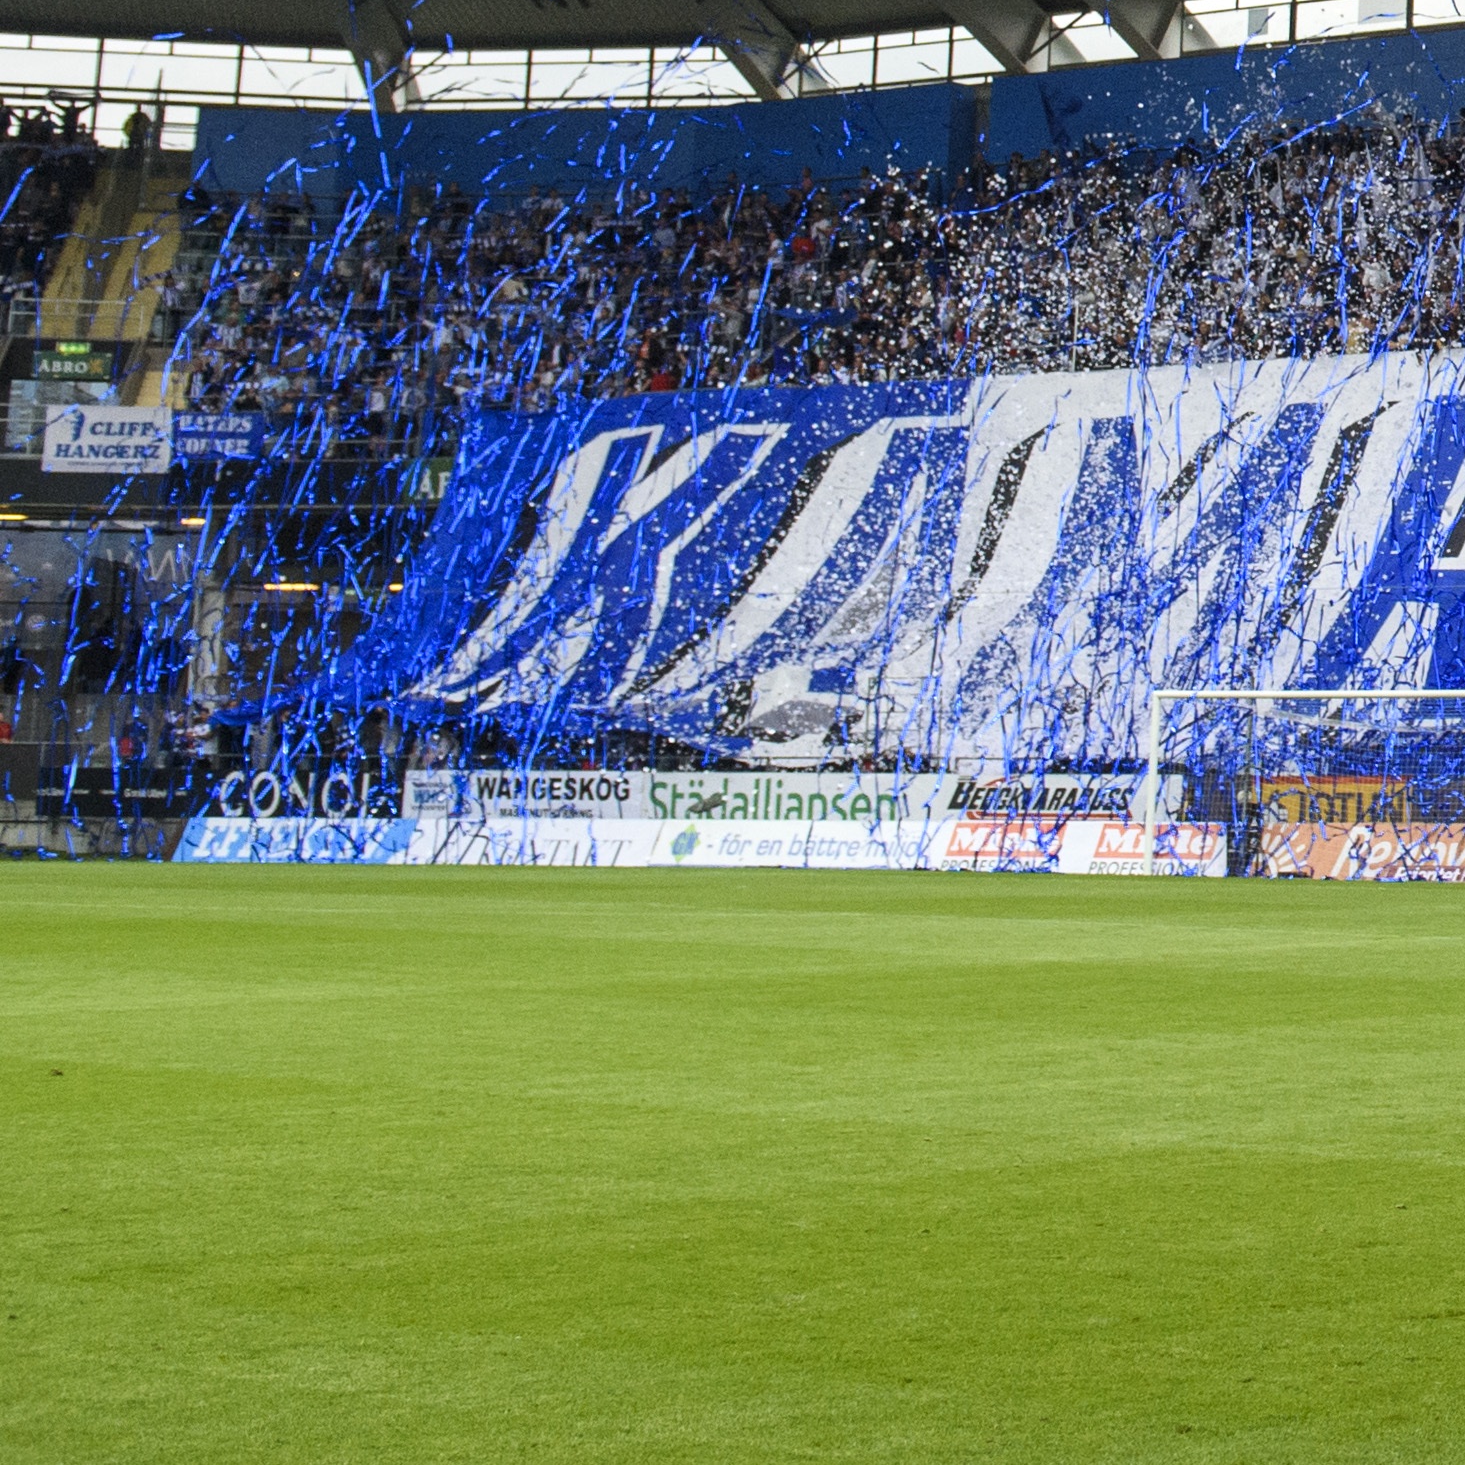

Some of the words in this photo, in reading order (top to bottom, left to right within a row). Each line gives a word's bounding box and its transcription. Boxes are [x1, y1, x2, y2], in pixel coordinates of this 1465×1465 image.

[55, 443, 162, 460] HANGERZ
[652, 778, 896, 820] Städalliansen
[717, 833, 751, 857] för
[757, 840, 782, 857] en
[788, 833, 860, 858] bättre
